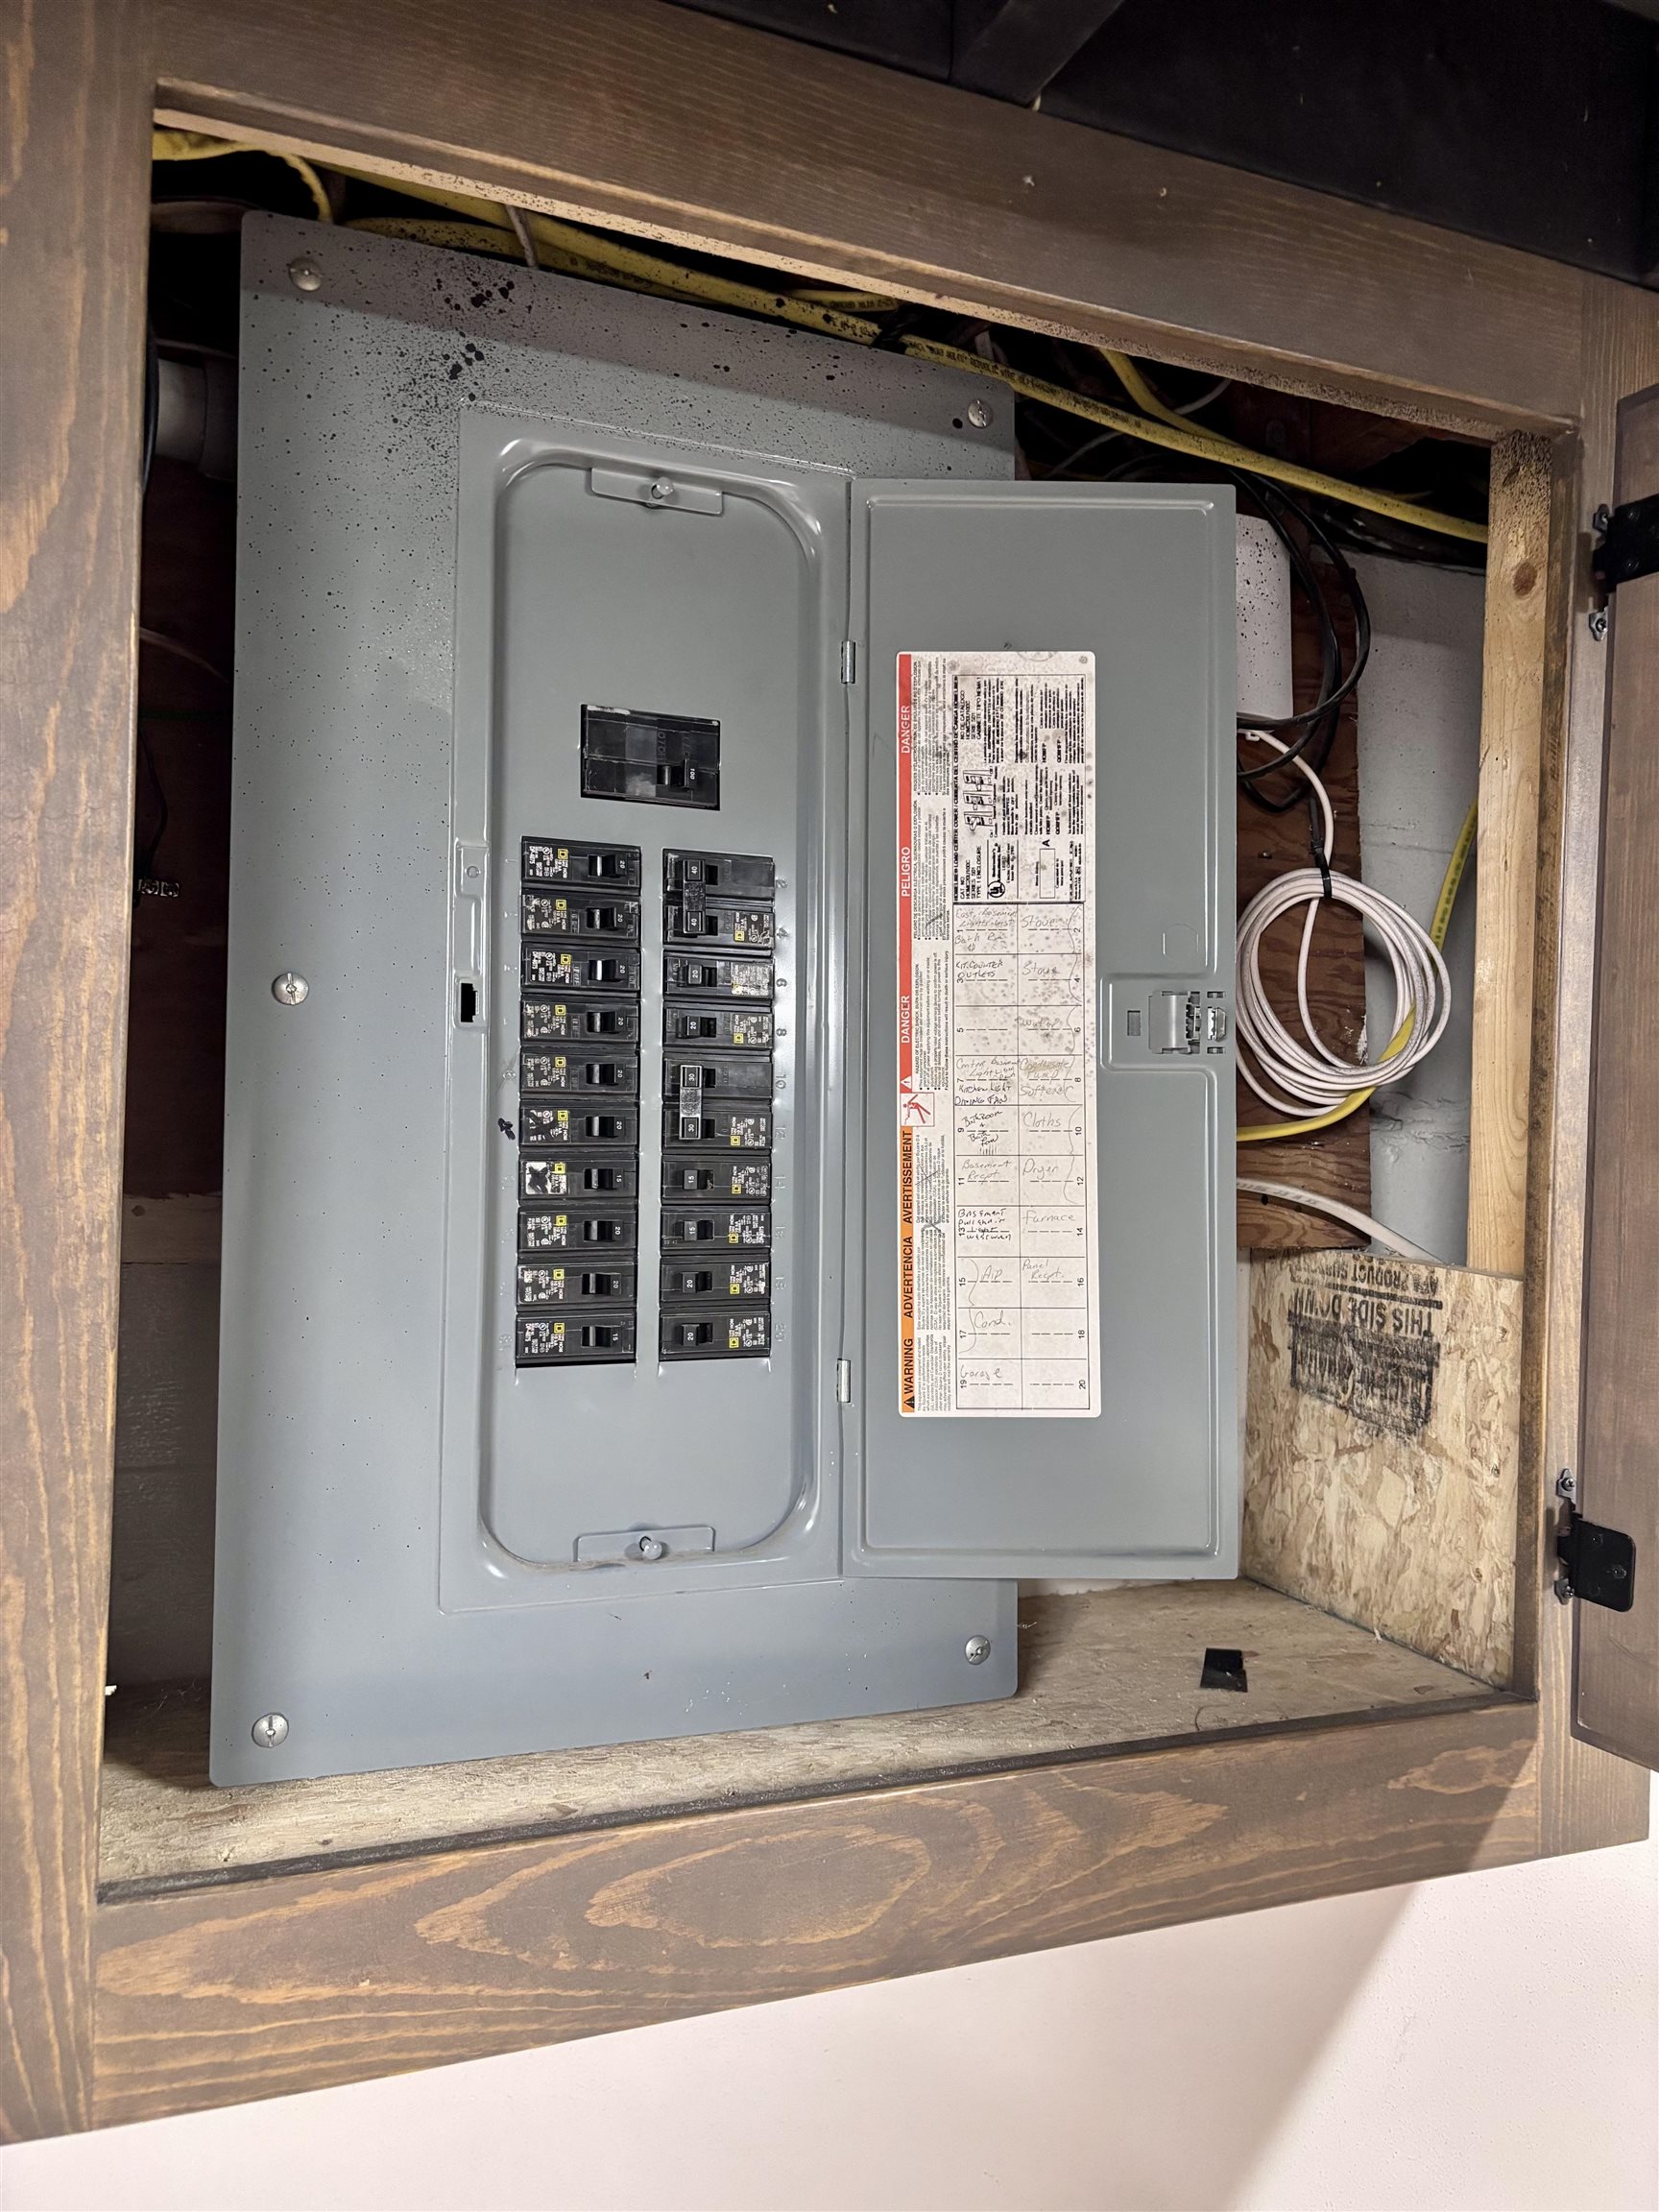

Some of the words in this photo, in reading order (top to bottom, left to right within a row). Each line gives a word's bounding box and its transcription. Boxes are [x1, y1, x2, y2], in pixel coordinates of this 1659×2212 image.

[901, 706, 910, 753] DANGER
[902, 846, 910, 897] PELIGRO
[901, 995, 910, 1043] DANGER
[902, 1131, 912, 1223] AVERTISSEMENT
[958, 1227, 965, 1237] 13
[1076, 1227, 1083, 1236] 14
[902, 1237, 913, 1317] ADVERTENCIA
[959, 1277, 966, 1286] 15
[1077, 1277, 1084, 1286] 16
[1348, 1296, 1387, 1331] SIDE
[1392, 1307, 1433, 1338] THIS
[1078, 1330, 1085, 1338] 18
[902, 1339, 913, 1394] WARNING
[960, 1380, 967, 1388] 19
[1079, 1380, 1086, 1390] 20
